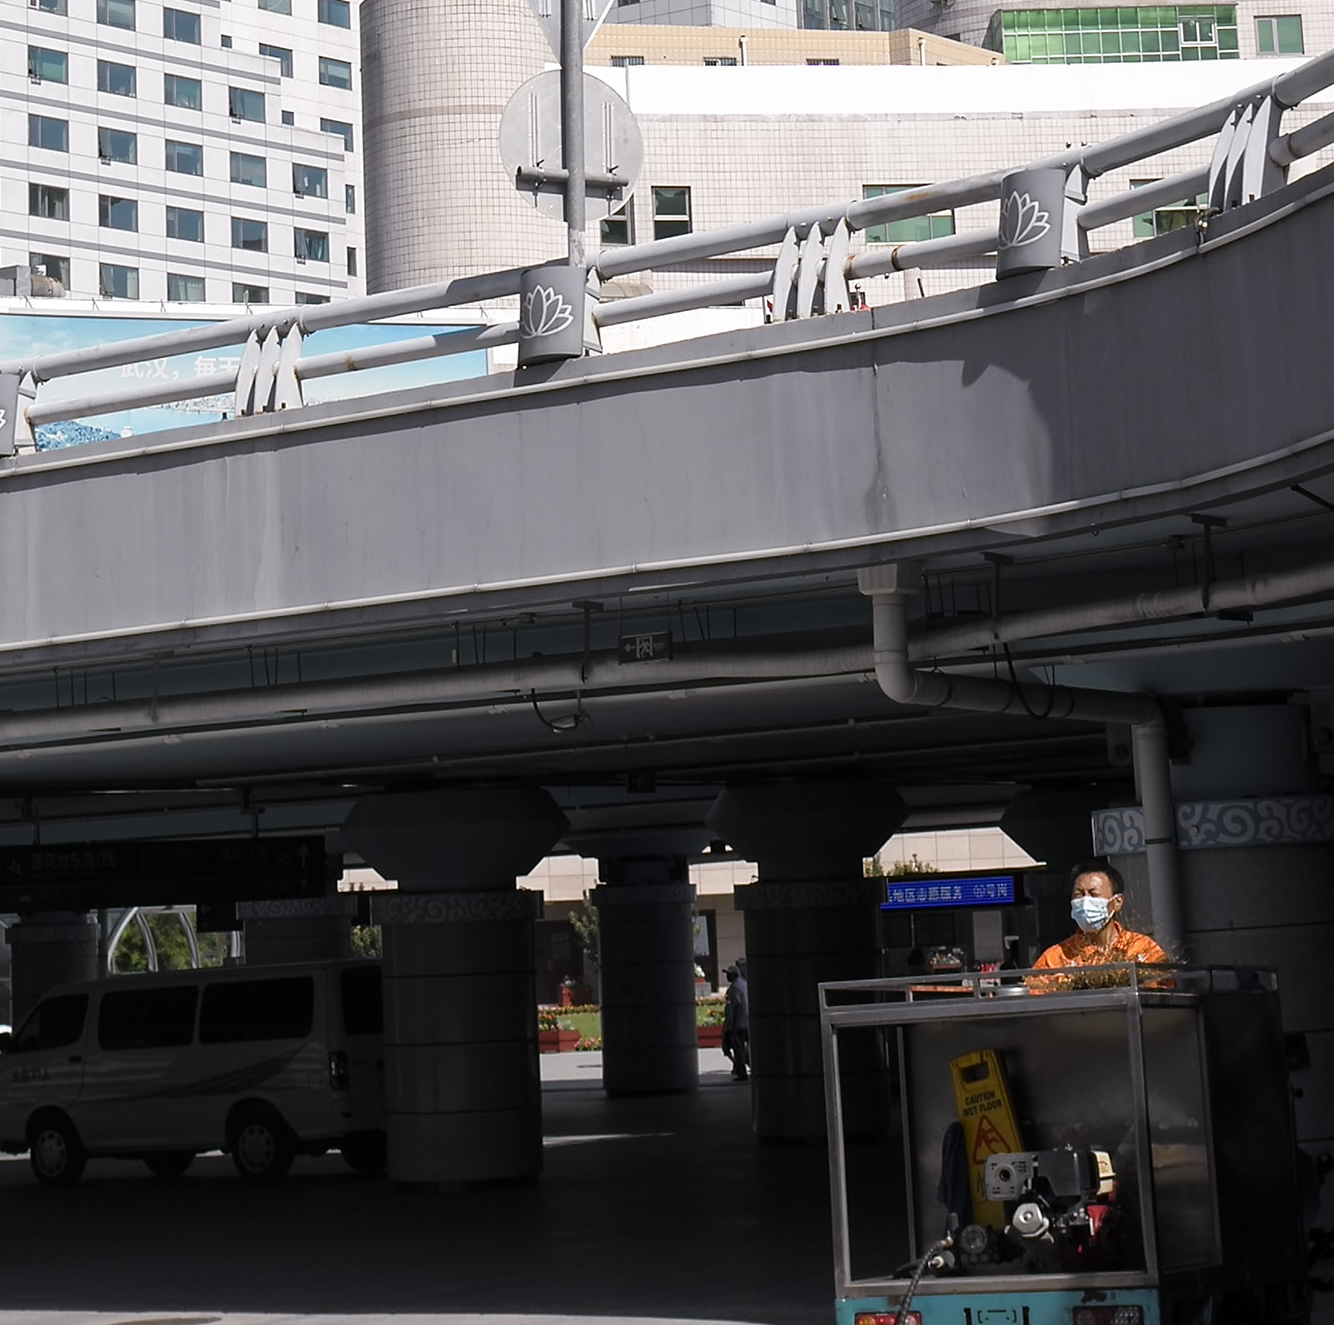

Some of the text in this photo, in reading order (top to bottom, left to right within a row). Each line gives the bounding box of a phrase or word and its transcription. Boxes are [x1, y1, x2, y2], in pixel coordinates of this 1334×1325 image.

[888, 886, 962, 903] 地区志愿服务
[965, 1090, 996, 1106] CAUTION
[963, 1099, 1002, 1117] WET FLOOR
